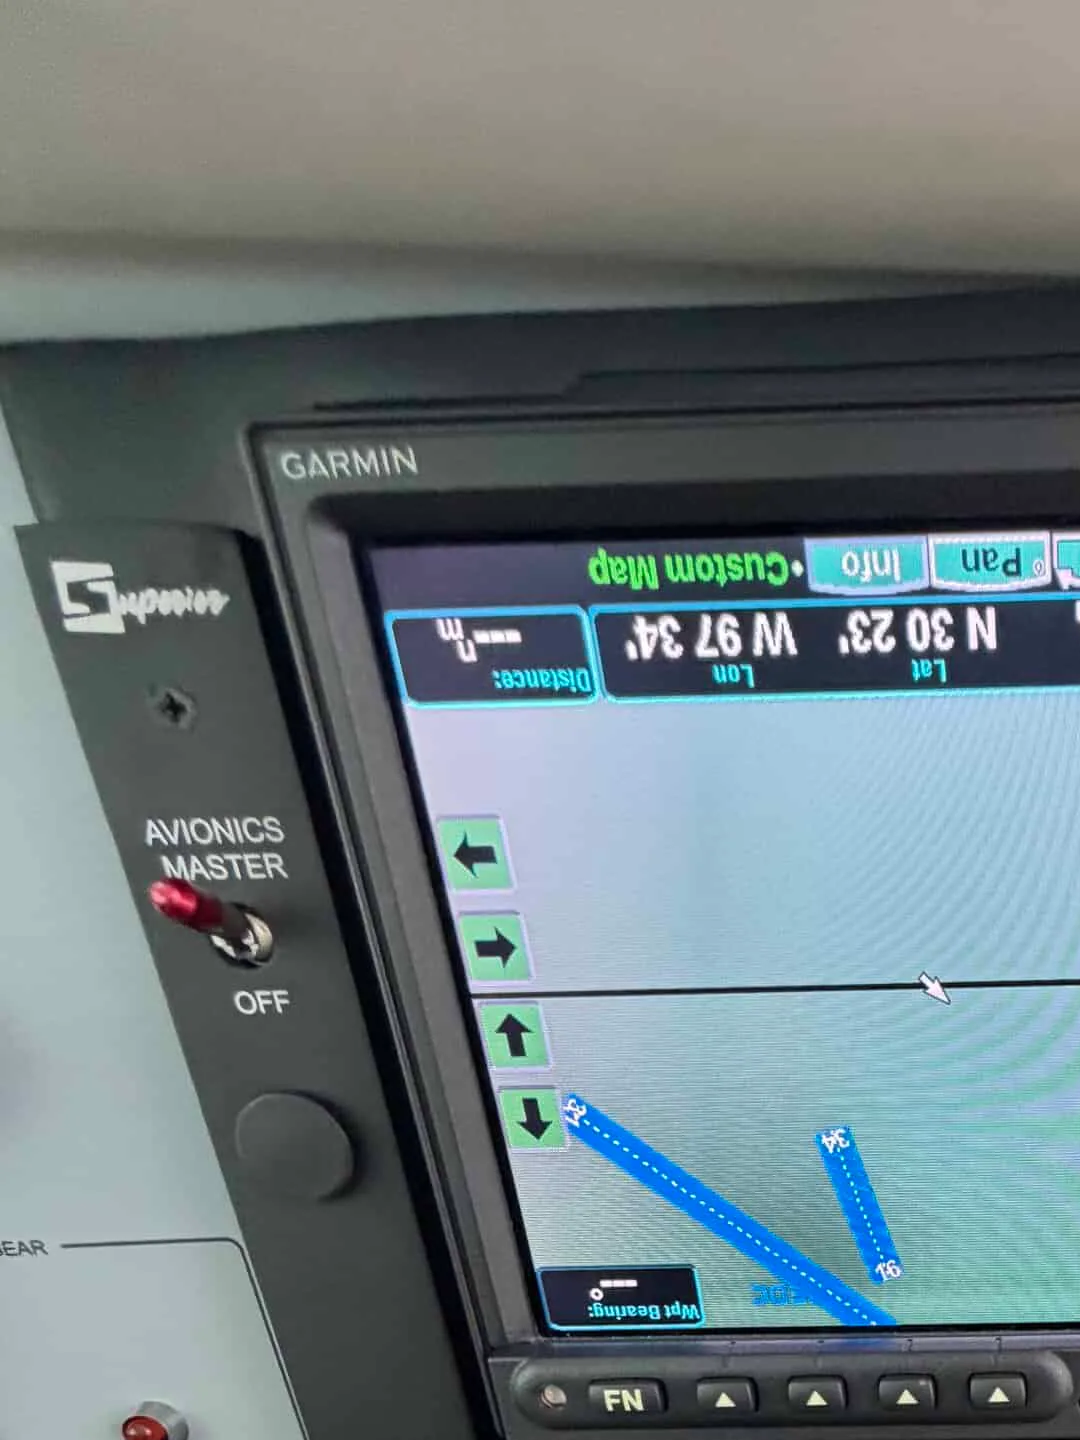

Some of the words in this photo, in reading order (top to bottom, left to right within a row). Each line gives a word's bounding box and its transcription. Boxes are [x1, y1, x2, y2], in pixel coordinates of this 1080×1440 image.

[281, 447, 419, 480] GARMIN
[589, 548, 659, 590] Map
[664, 551, 789, 588] Custom
[842, 550, 900, 581] Info
[962, 545, 1021, 577] Pan
[696, 614, 744, 657] 97
[753, 613, 796, 655] W
[906, 608, 955, 651] 30
[969, 606, 997, 650] N
[495, 668, 593, 693] Distance:
[713, 664, 754, 687] Lon
[911, 655, 947, 682] Lat
[145, 817, 285, 849] AVIONICS
[162, 853, 288, 882] MASTER
[233, 989, 290, 1015] OFF
[590, 1303, 659, 1320] Bearing:
[661, 1302, 699, 1320] Wpt
[604, 1388, 643, 1412] FN
